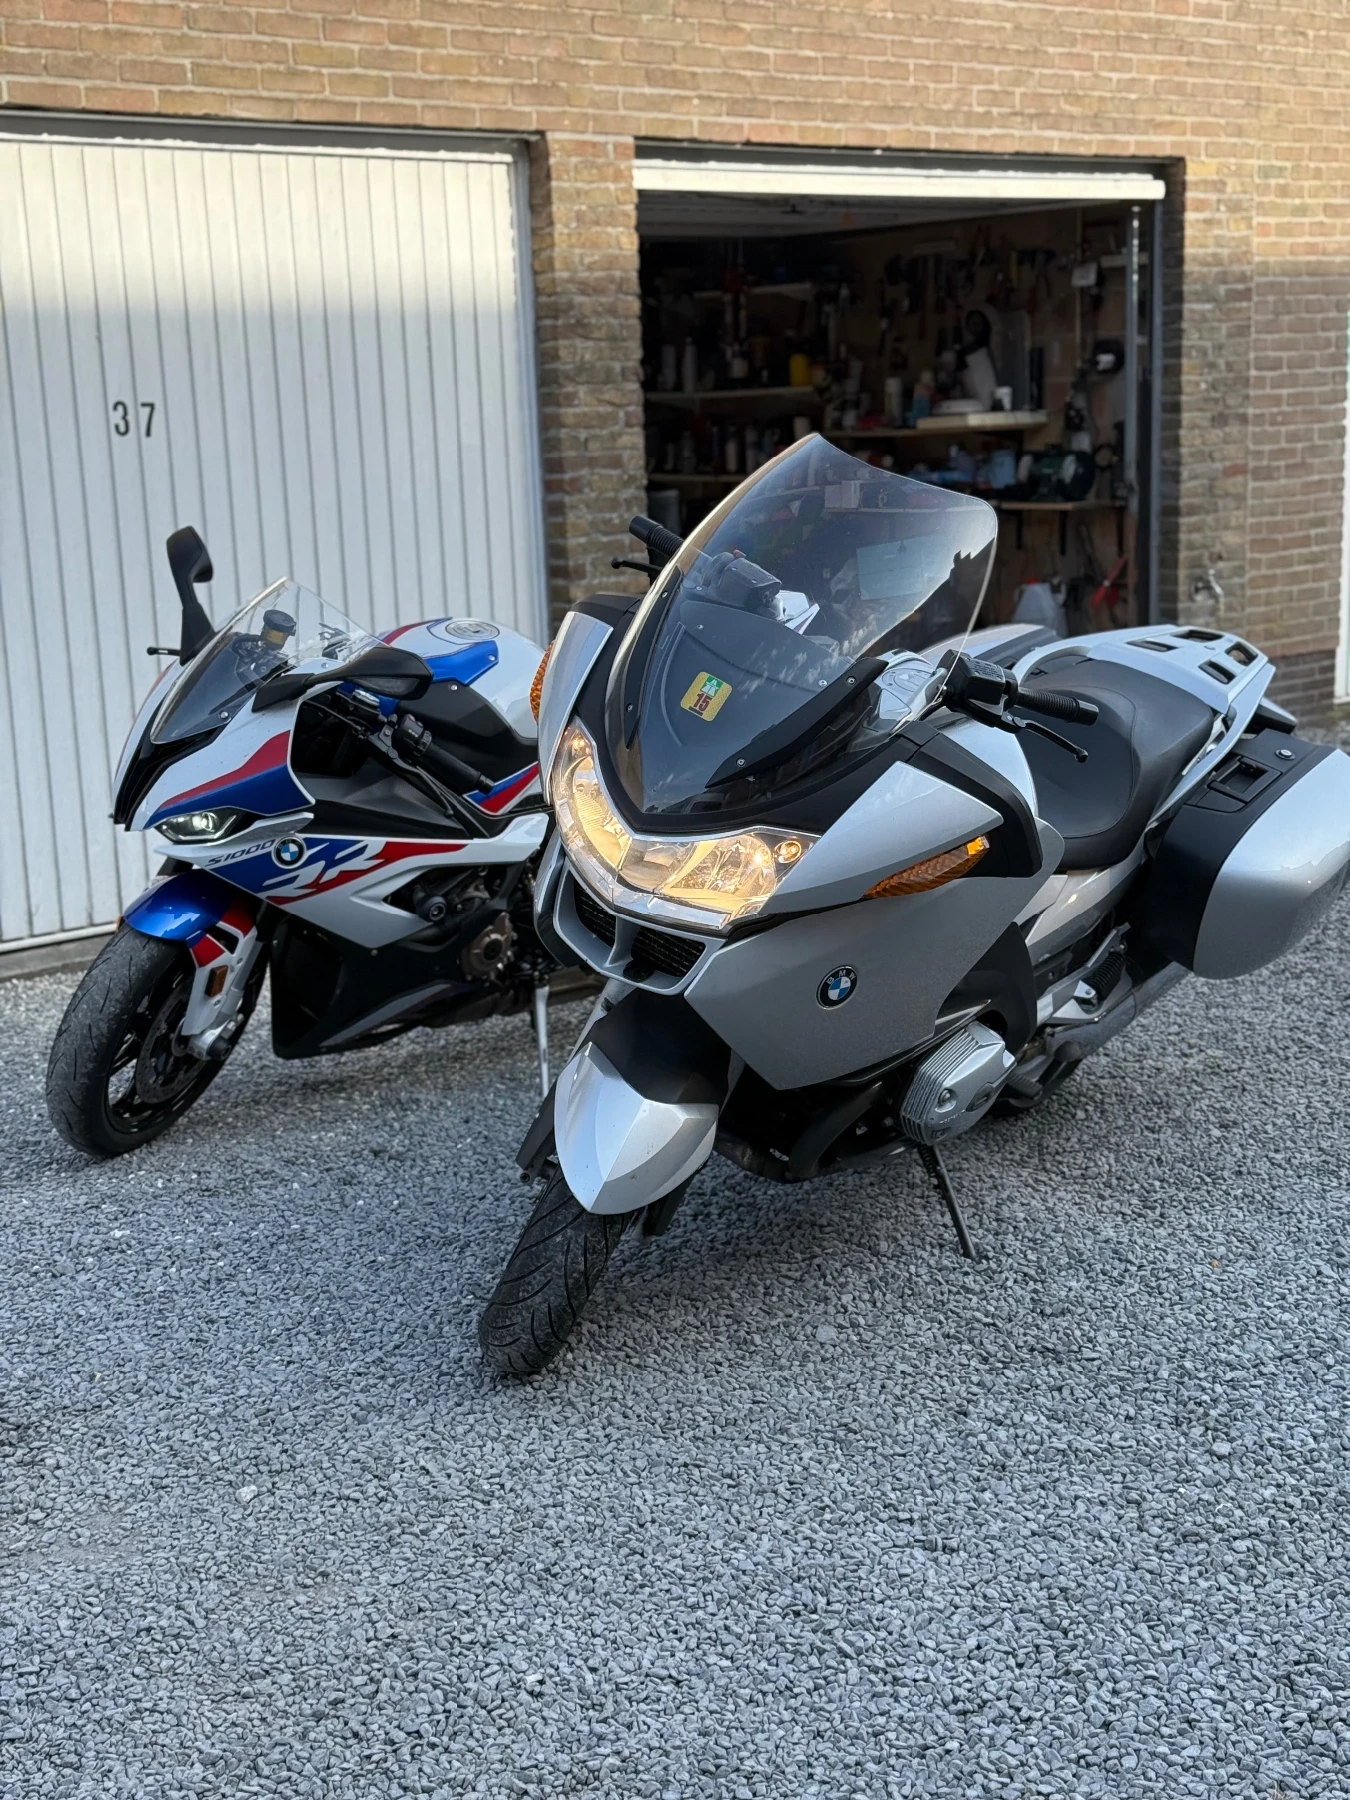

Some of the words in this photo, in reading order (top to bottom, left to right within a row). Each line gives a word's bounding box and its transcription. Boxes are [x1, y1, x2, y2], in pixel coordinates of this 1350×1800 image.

[112, 400, 155, 438] 37
[693, 692, 713, 712] 15
[204, 838, 277, 867] S1000
[826, 969, 856, 985] BMW
